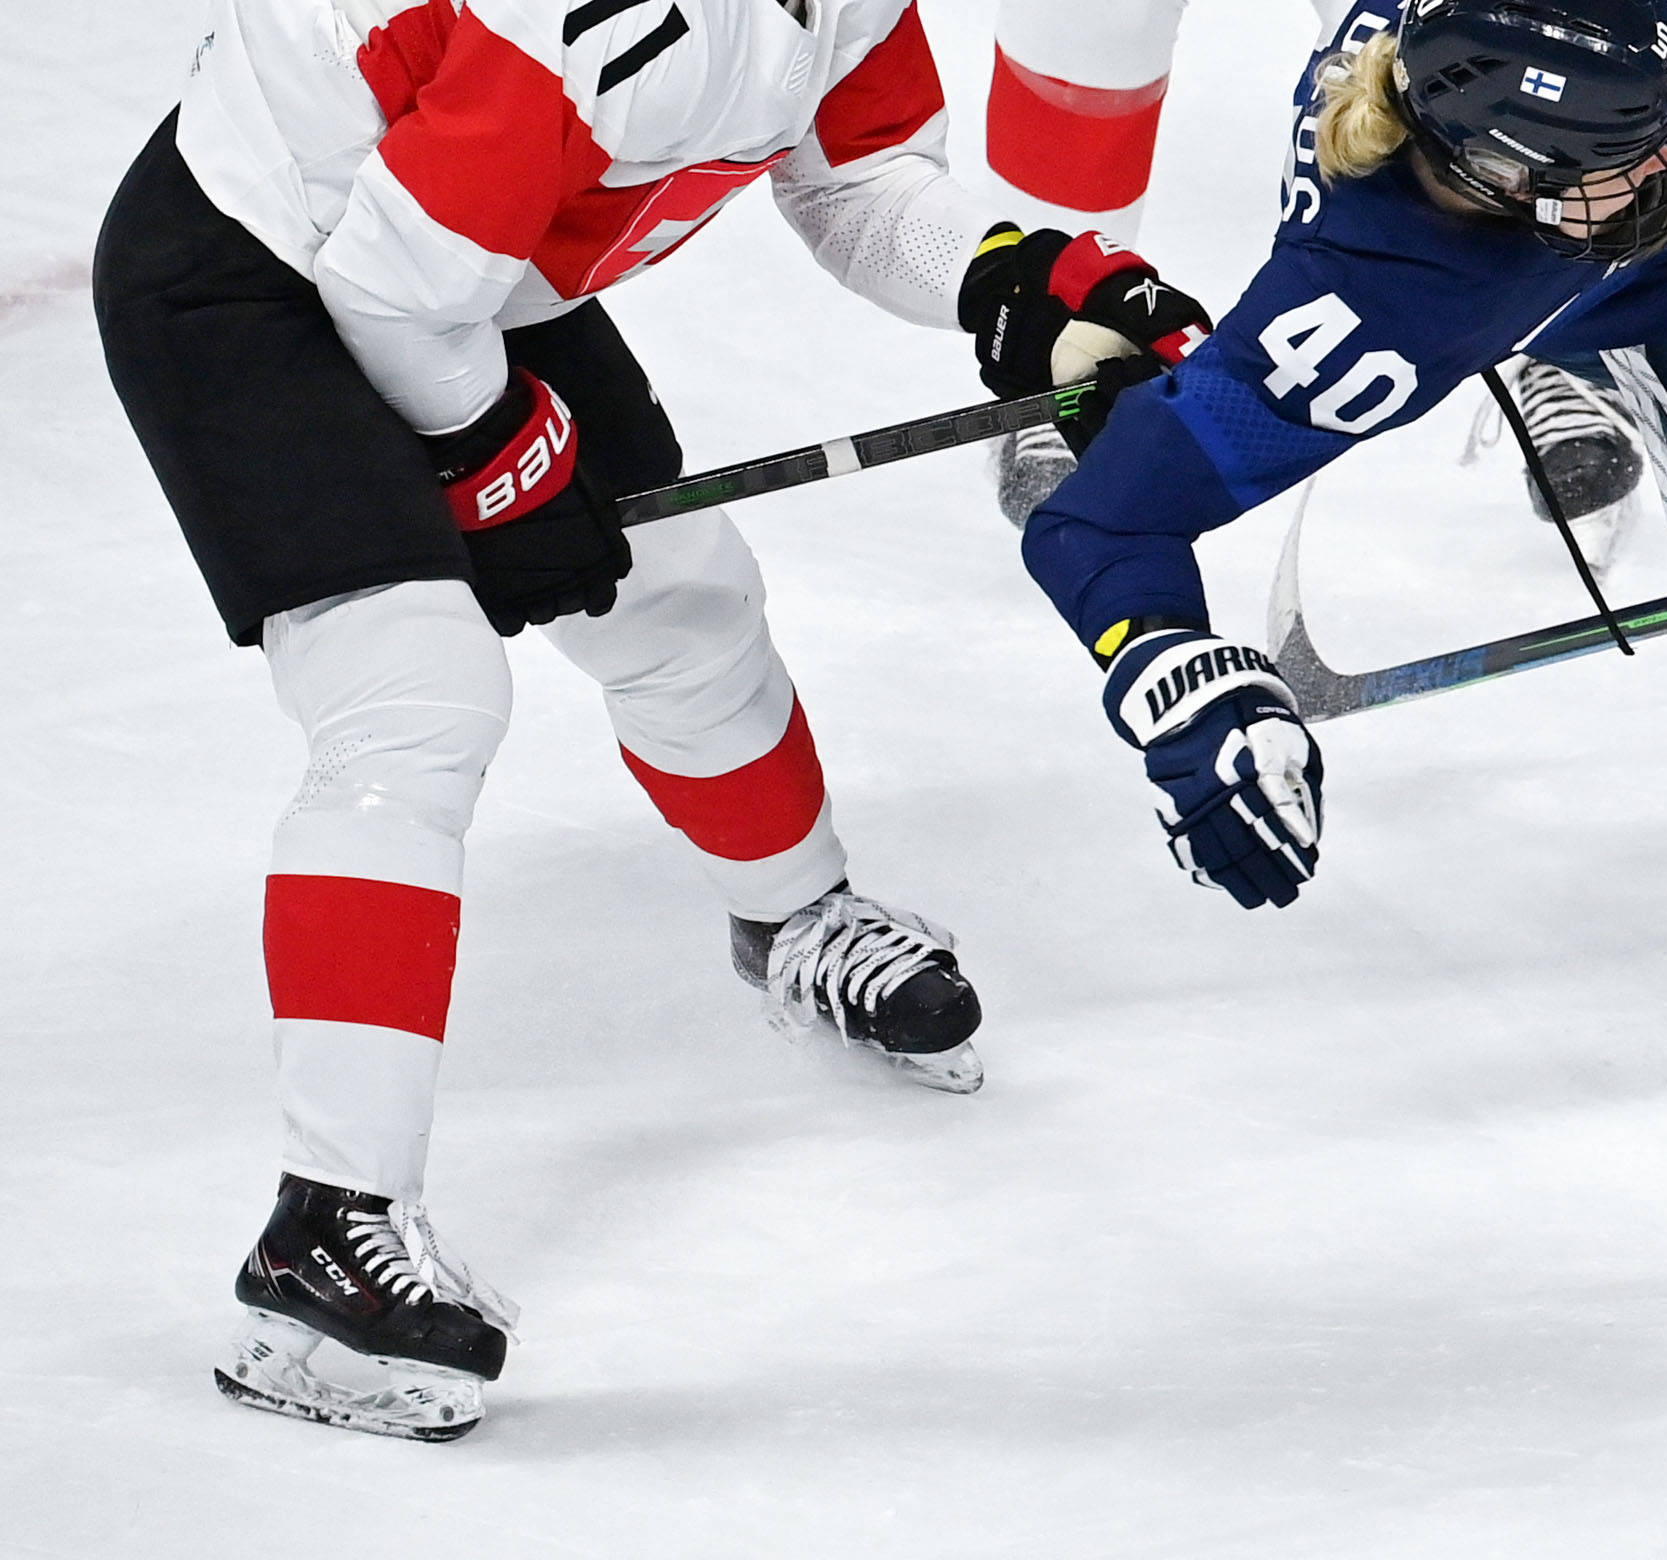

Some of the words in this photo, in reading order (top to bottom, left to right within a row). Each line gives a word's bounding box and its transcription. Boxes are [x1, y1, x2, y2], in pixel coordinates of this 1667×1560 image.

[989, 304, 1012, 363] BAUER
[1257, 291, 1419, 435] 40
[309, 1244, 360, 1297] CCM
